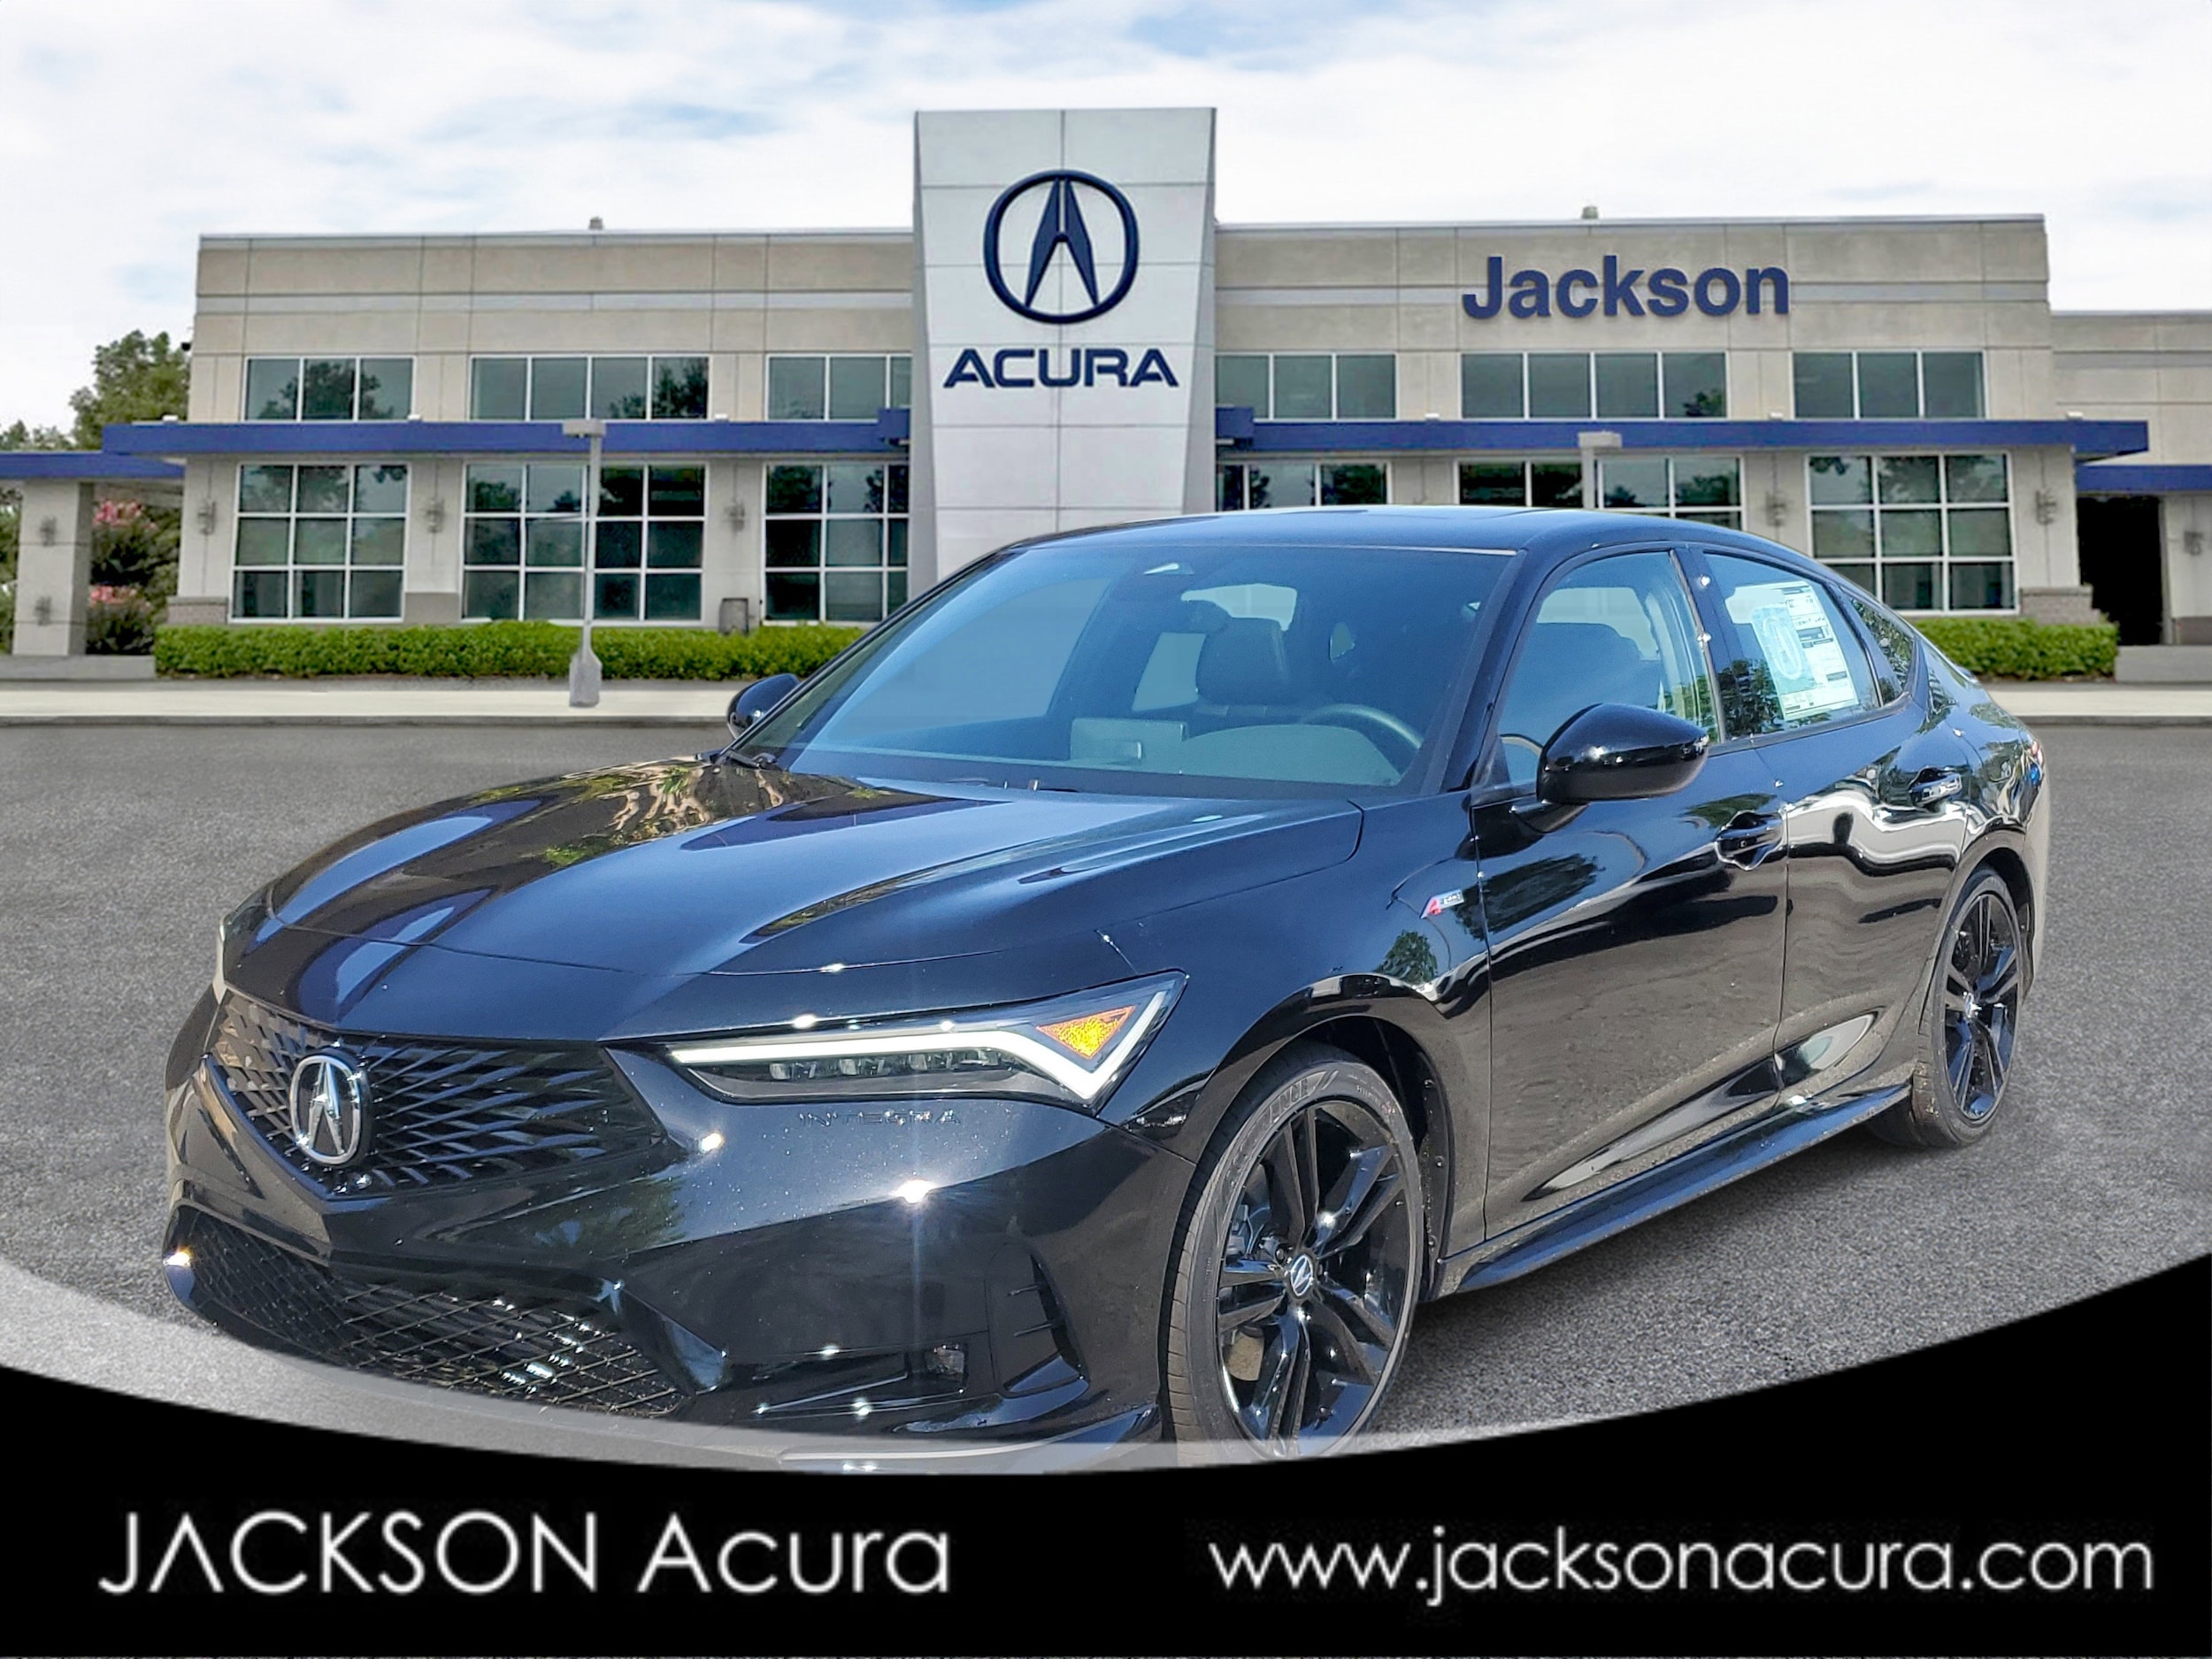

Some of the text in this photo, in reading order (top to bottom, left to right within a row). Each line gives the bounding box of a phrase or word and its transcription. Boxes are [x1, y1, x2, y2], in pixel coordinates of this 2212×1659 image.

[1461, 254, 1790, 322] Jackson
[943, 348, 1179, 388] ACURA
[799, 1108, 962, 1127] INTEGRA
